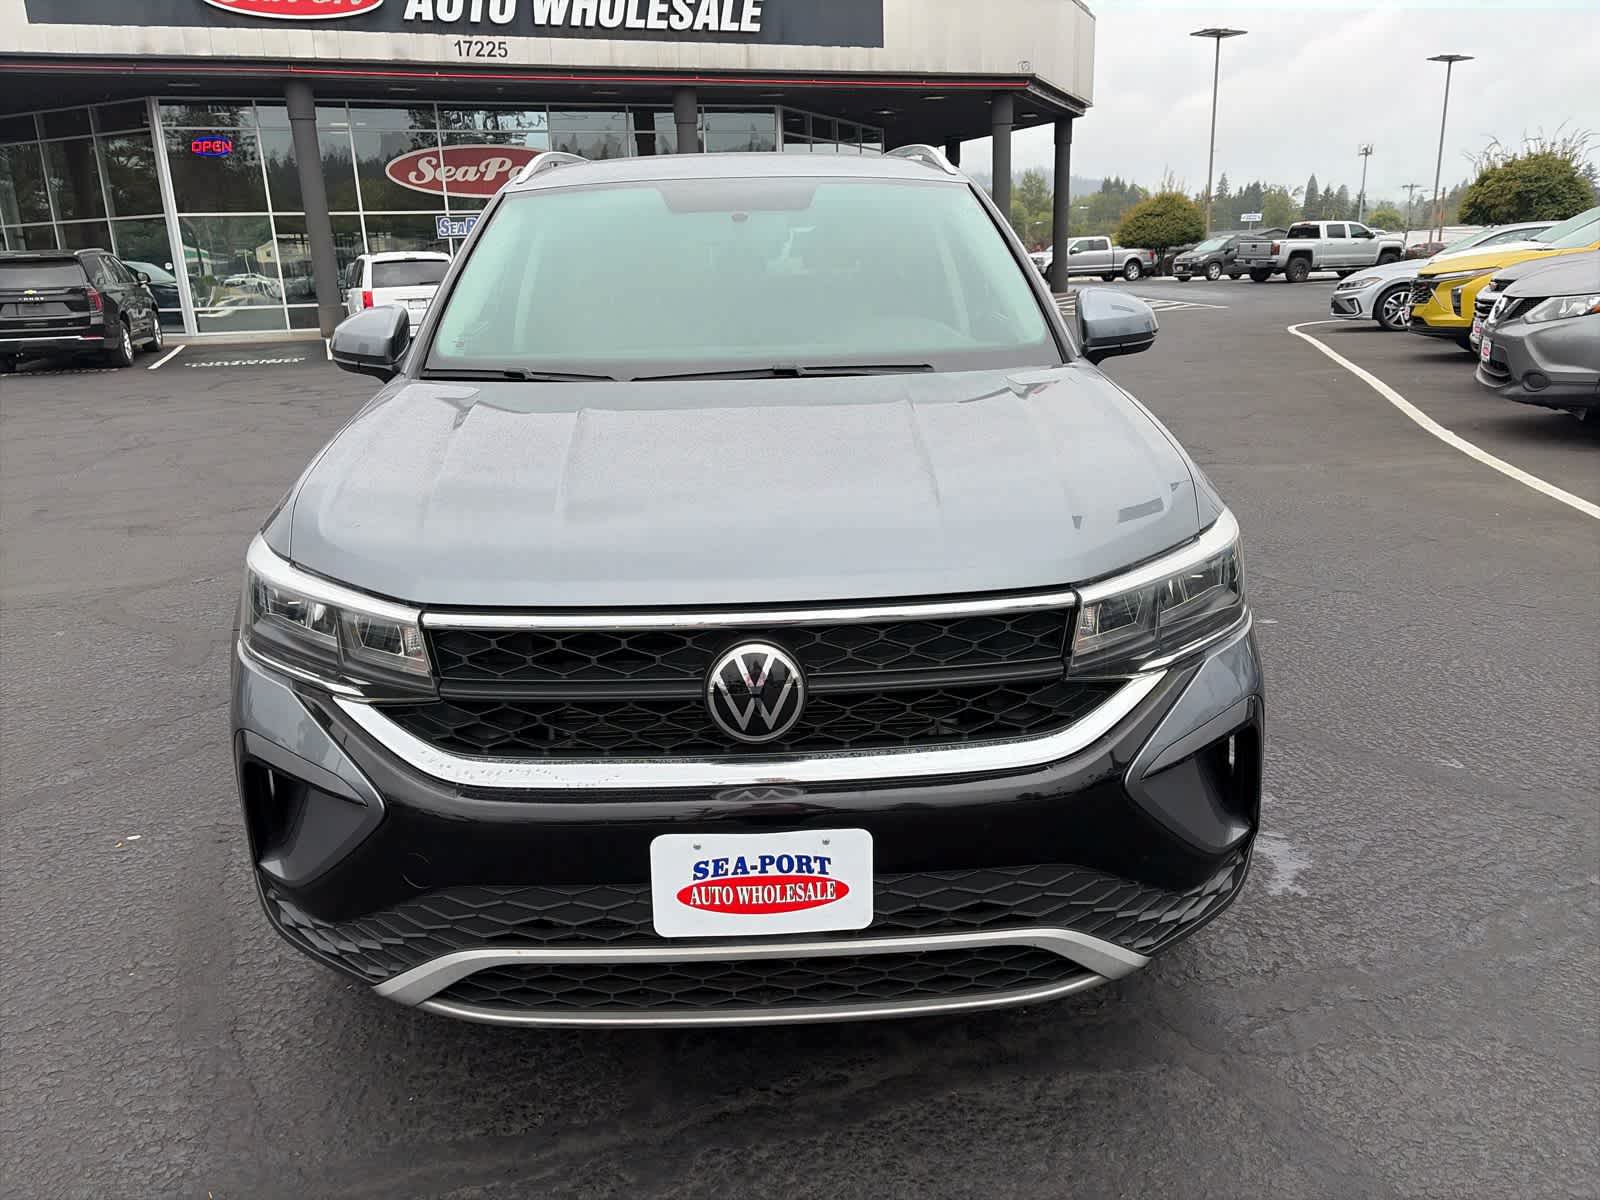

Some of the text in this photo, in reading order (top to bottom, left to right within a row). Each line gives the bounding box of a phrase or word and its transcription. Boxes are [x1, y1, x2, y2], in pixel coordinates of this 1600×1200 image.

[403, 0, 761, 32] AUTO WHOLESALE
[453, 39, 509, 59] 17225
[191, 140, 233, 152] OPEN
[692, 854, 832, 881] SEA-PORT
[689, 880, 837, 906] AUTO WHOLESALE
